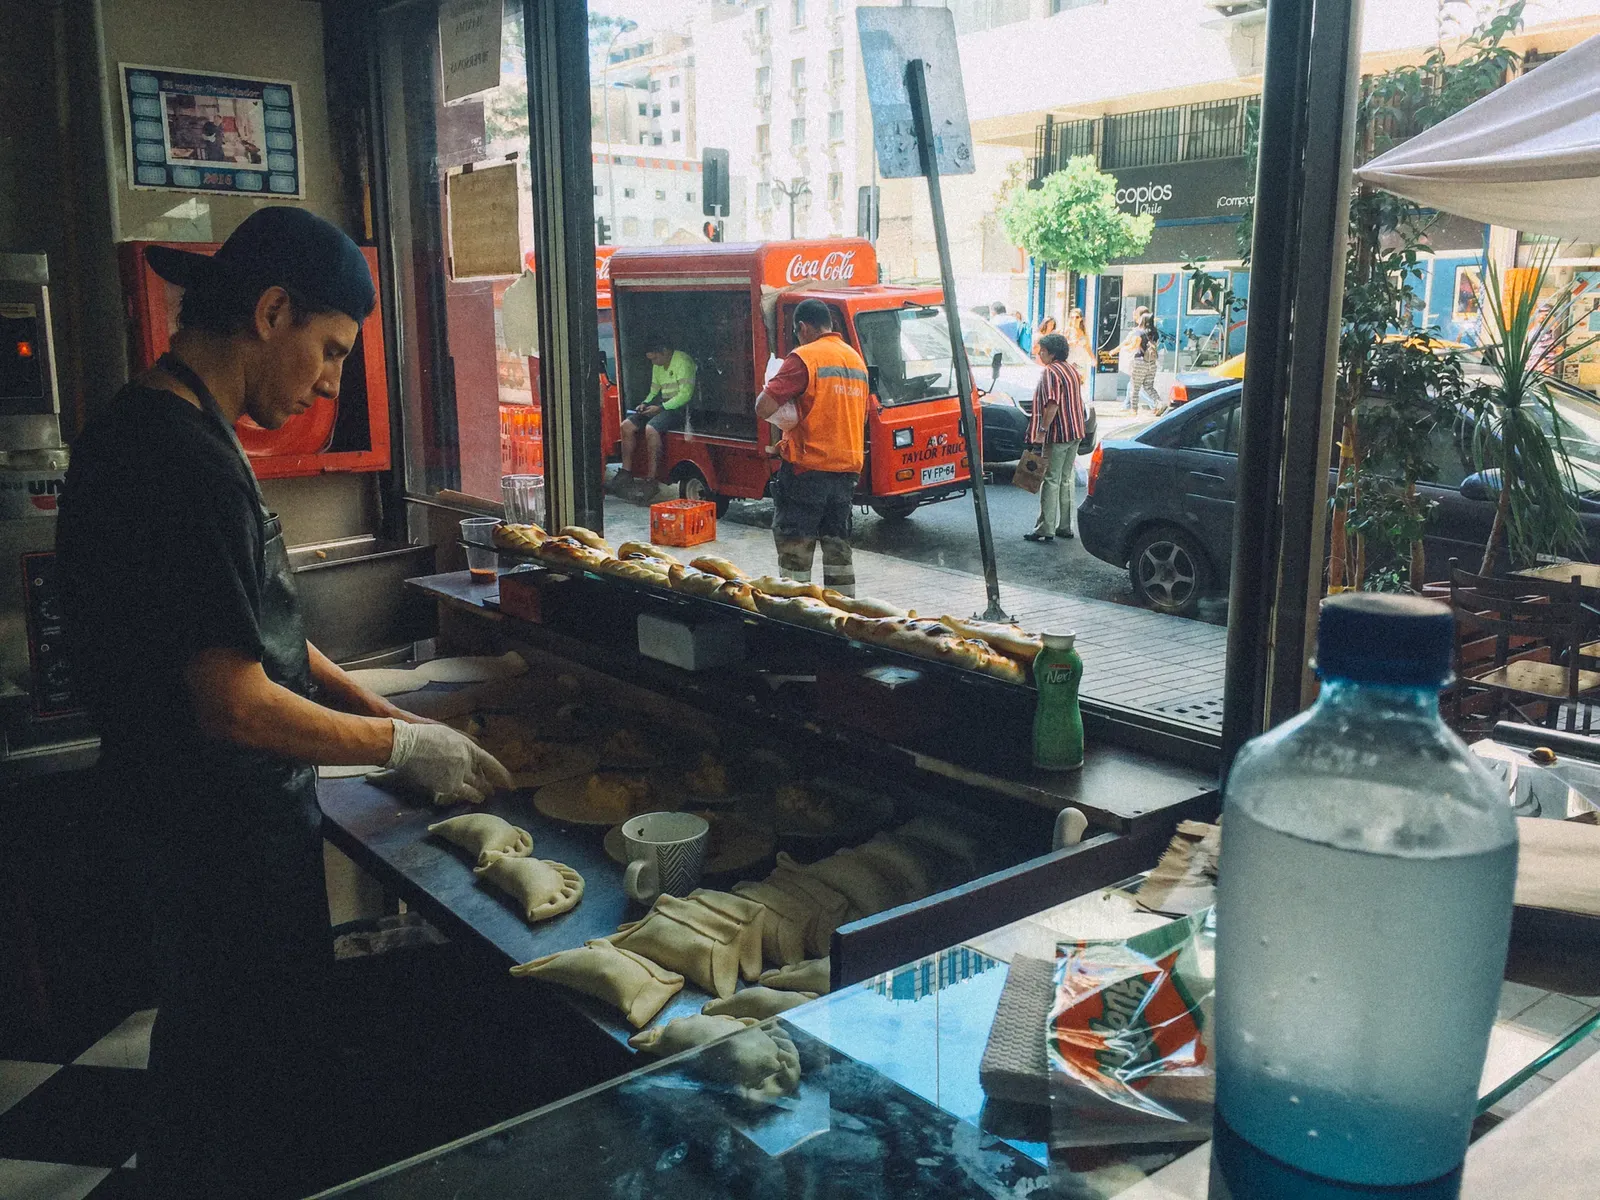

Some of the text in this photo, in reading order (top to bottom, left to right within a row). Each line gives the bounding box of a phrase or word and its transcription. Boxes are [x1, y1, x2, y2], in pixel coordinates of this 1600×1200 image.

[1140, 203, 1163, 214] Chile
[786, 250, 856, 284] Coca Cola
[902, 442, 967, 465] TAYLOR TRUC
[922, 469, 932, 481] FV
[1046, 669, 1072, 683] Next
